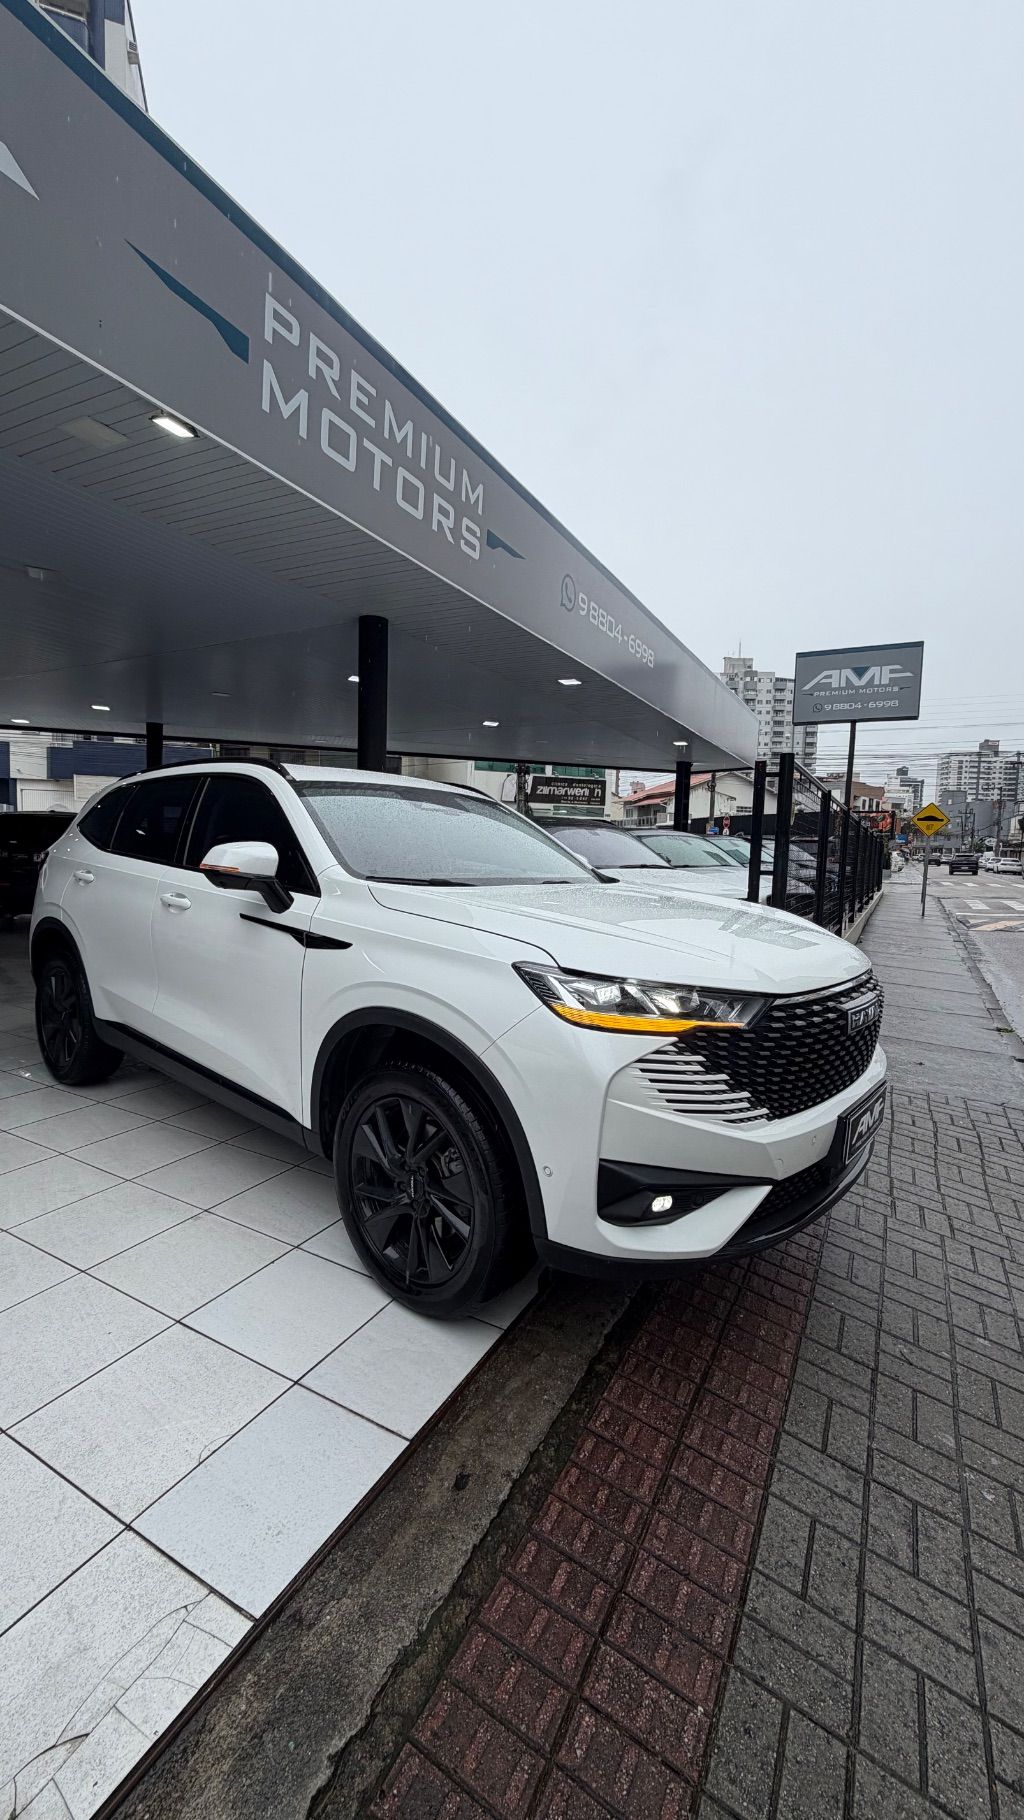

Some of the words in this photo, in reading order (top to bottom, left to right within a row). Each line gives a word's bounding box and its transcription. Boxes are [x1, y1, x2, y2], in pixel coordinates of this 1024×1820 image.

[264, 292, 484, 516] PREMIUM
[261, 358, 481, 561] MOTORS
[578, 592, 588, 615] 9
[589, 601, 655, 668] 8804-6998
[801, 665, 914, 690] AMF
[833, 700, 899, 710] 8804-6998
[851, 1097, 884, 1145] AMF
